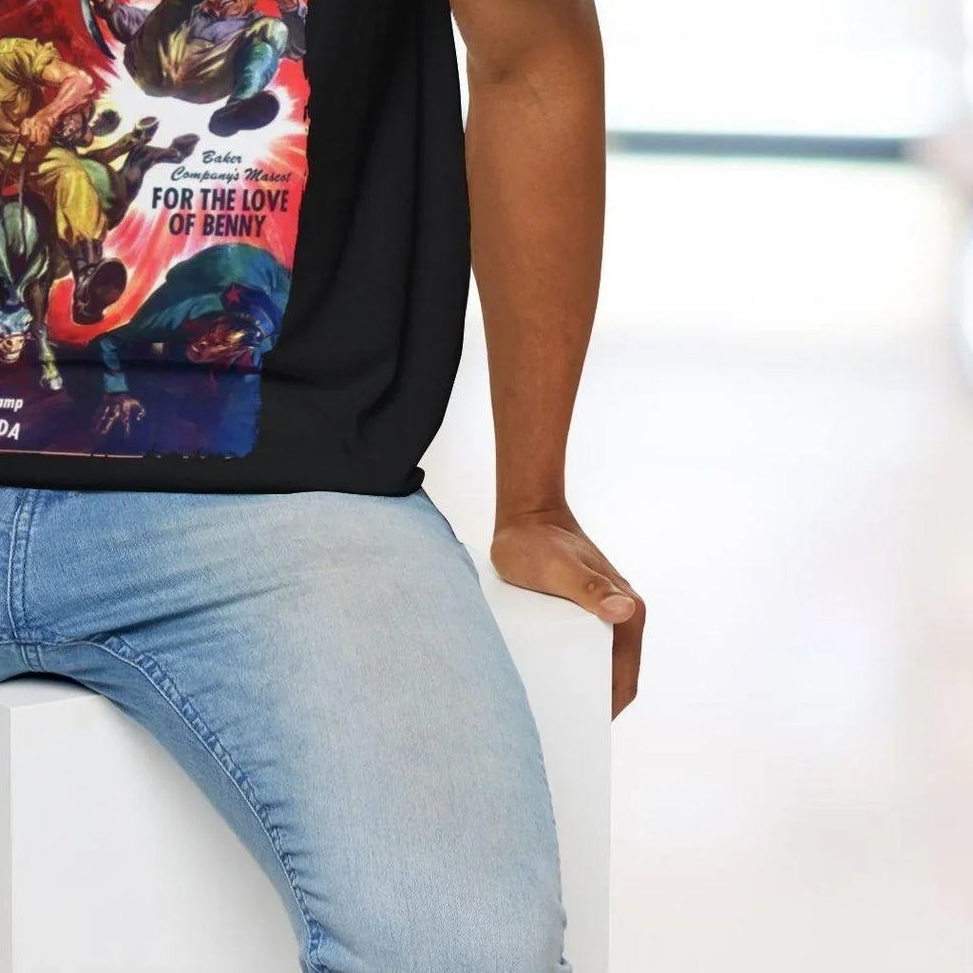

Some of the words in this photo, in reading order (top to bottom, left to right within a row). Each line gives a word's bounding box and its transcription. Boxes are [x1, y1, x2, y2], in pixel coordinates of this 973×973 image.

[202, 149, 244, 164] Baker
[171, 165, 240, 184] Company's
[151, 187, 194, 210] FOR
[200, 188, 236, 211] THE
[242, 189, 289, 212] LOVE
[169, 213, 196, 236] OF
[202, 213, 267, 238] BENNY
